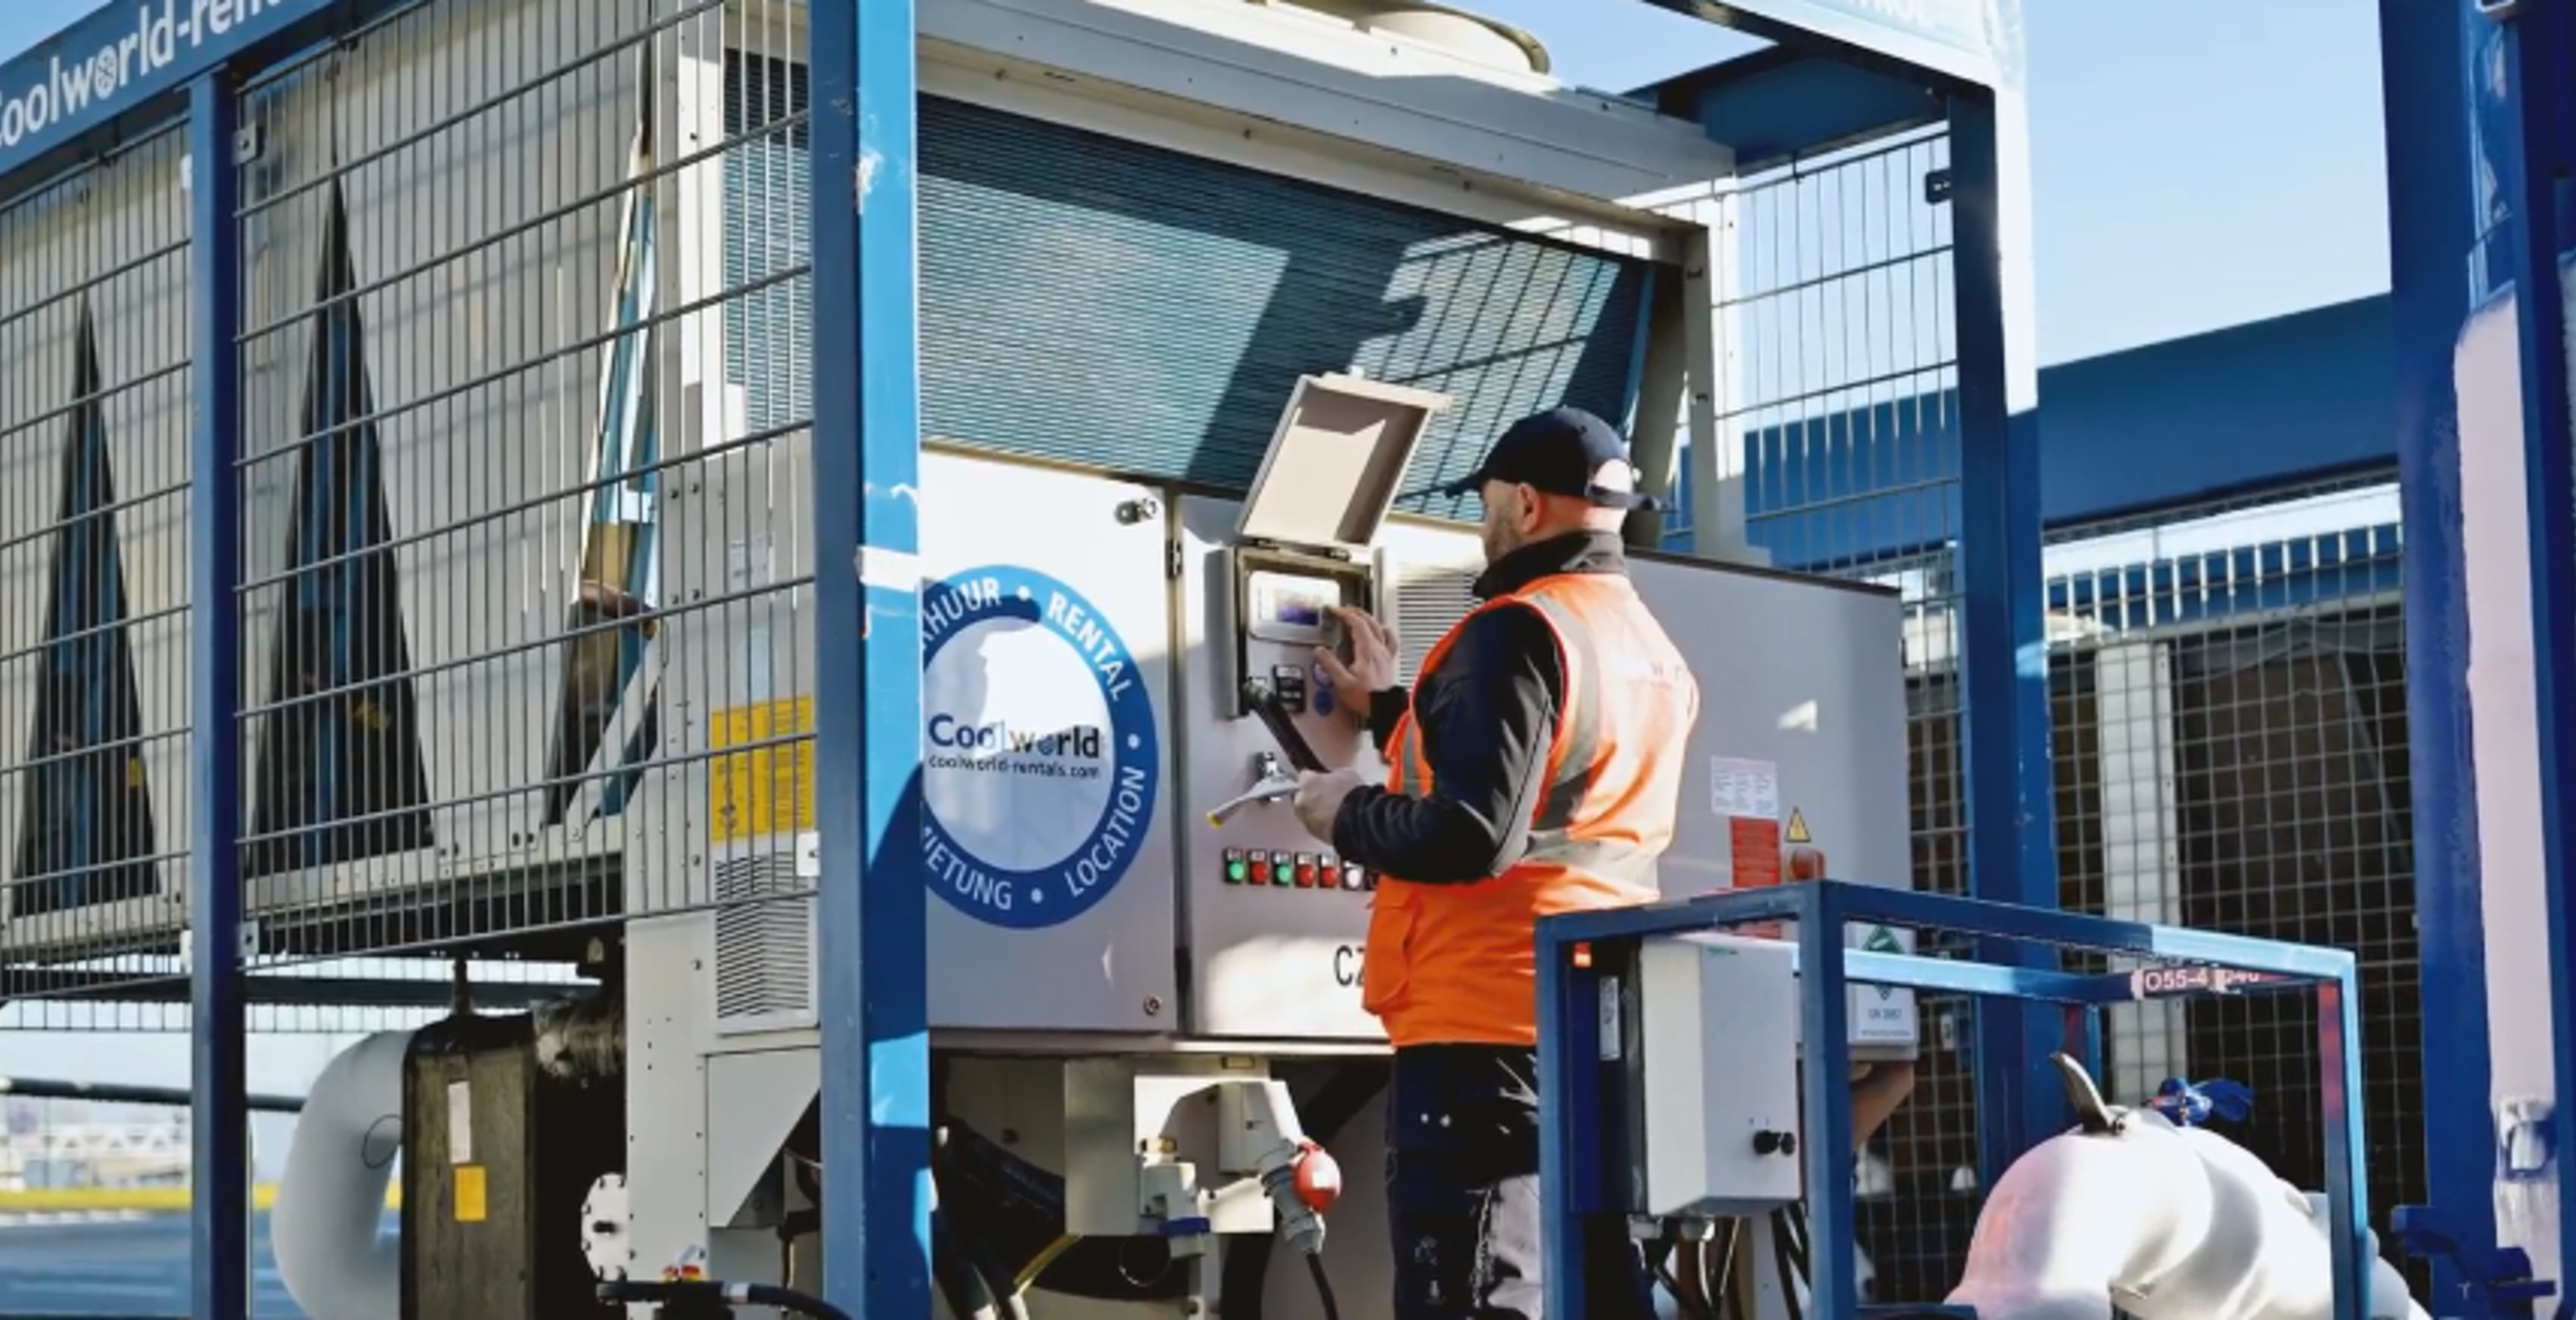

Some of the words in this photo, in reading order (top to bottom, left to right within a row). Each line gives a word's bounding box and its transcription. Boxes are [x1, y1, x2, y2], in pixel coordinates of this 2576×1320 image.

[922, 576, 1002, 650] HUUR
[1047, 591, 1132, 702] RENTAL
[924, 826, 1012, 911] IETUNG
[1064, 766, 1146, 897] LOCATION
